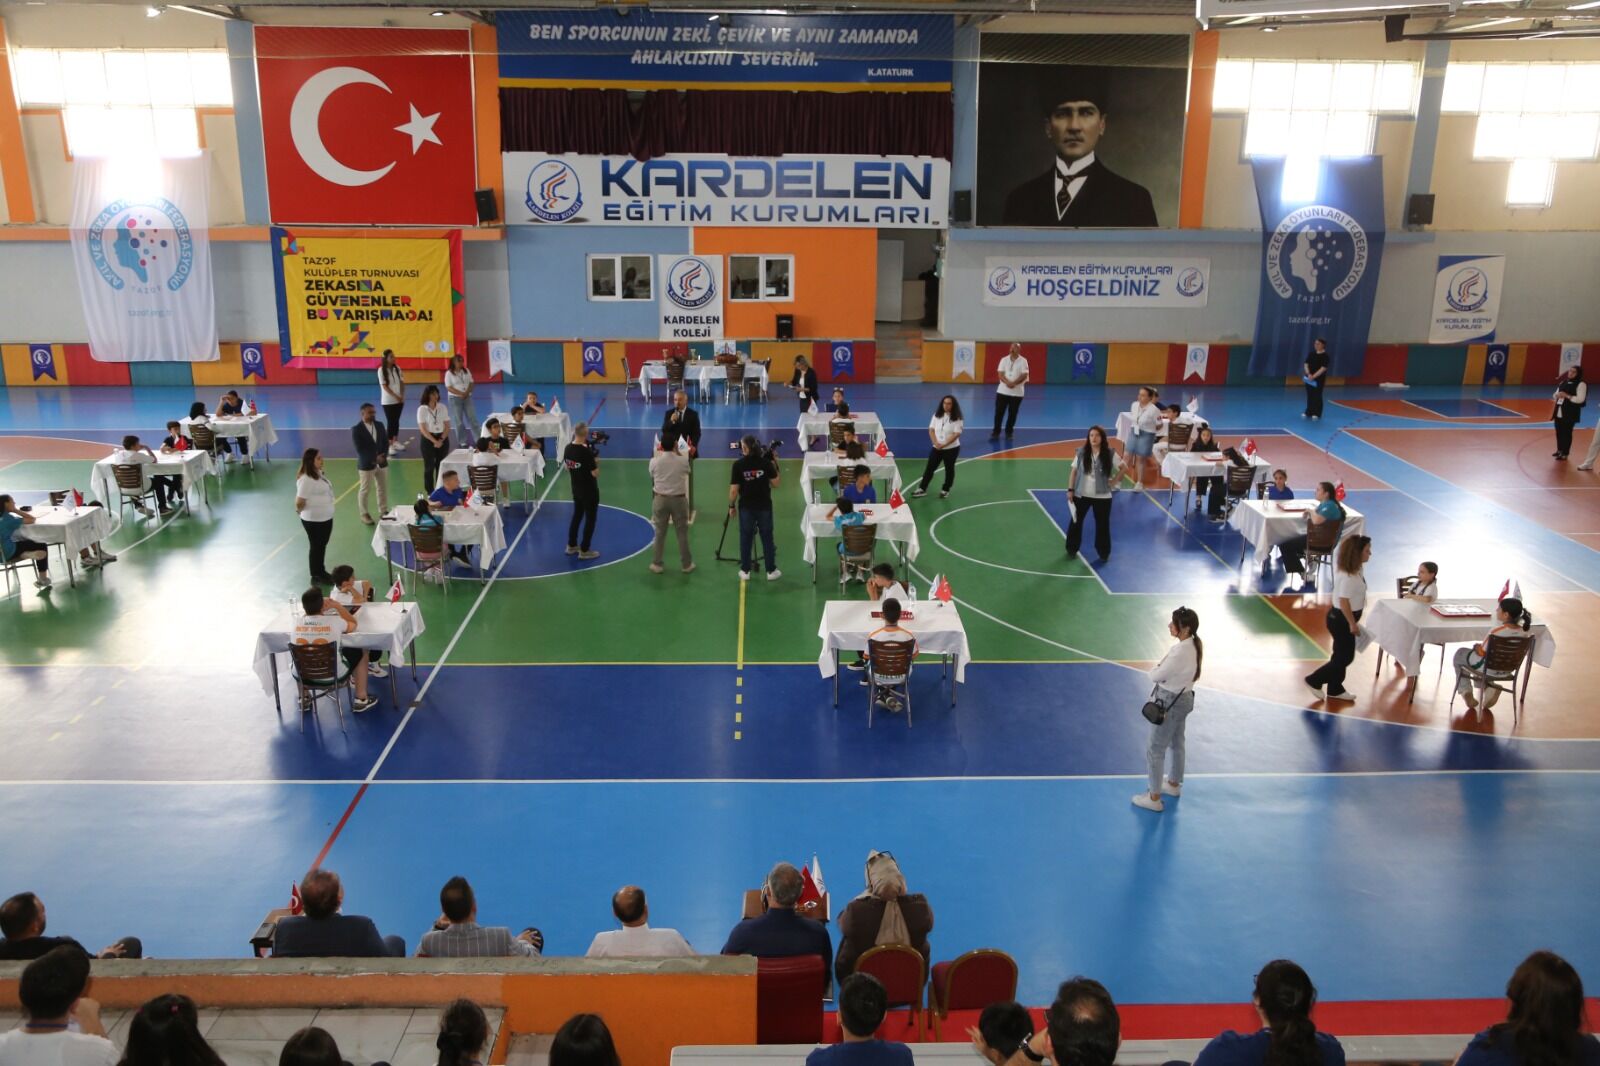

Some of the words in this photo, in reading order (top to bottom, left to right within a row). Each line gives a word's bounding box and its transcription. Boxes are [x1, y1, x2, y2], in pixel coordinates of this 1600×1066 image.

[530, 24, 564, 40] BEN
[568, 25, 668, 42] SPORCUNUN
[717, 24, 767, 45] ÇEVİK
[771, 27, 792, 43] VE
[796, 28, 835, 43] AYNI
[838, 28, 919, 44] ZAMANDA
[601, 159, 932, 200] KARDELEN
[603, 200, 712, 222] EĞİTİM
[731, 204, 930, 224] KURUMLARI
[1289, 207, 1345, 224] OYUNLARI
[1335, 220, 1365, 298] FEDERASYONU
[303, 257, 336, 265] TAZOF
[304, 267, 358, 277] KULÜPLER
[360, 269, 419, 278] TURNUVASI
[1021, 265, 1076, 275] KARDELEN
[1079, 263, 1111, 275] EĞİTİM
[1113, 265, 1173, 276] KURUMLARI
[304, 279, 385, 292] ZEKASINA
[1027, 275, 1160, 300] HOŞGELDİNİZ
[306, 292, 412, 307] GÜVENENLER
[307, 309, 329, 321] BU
[333, 309, 433, 324] YARIŞMADA!
[664, 315, 720, 325] KARDELEN
[673, 326, 711, 337] KOLEJİ
